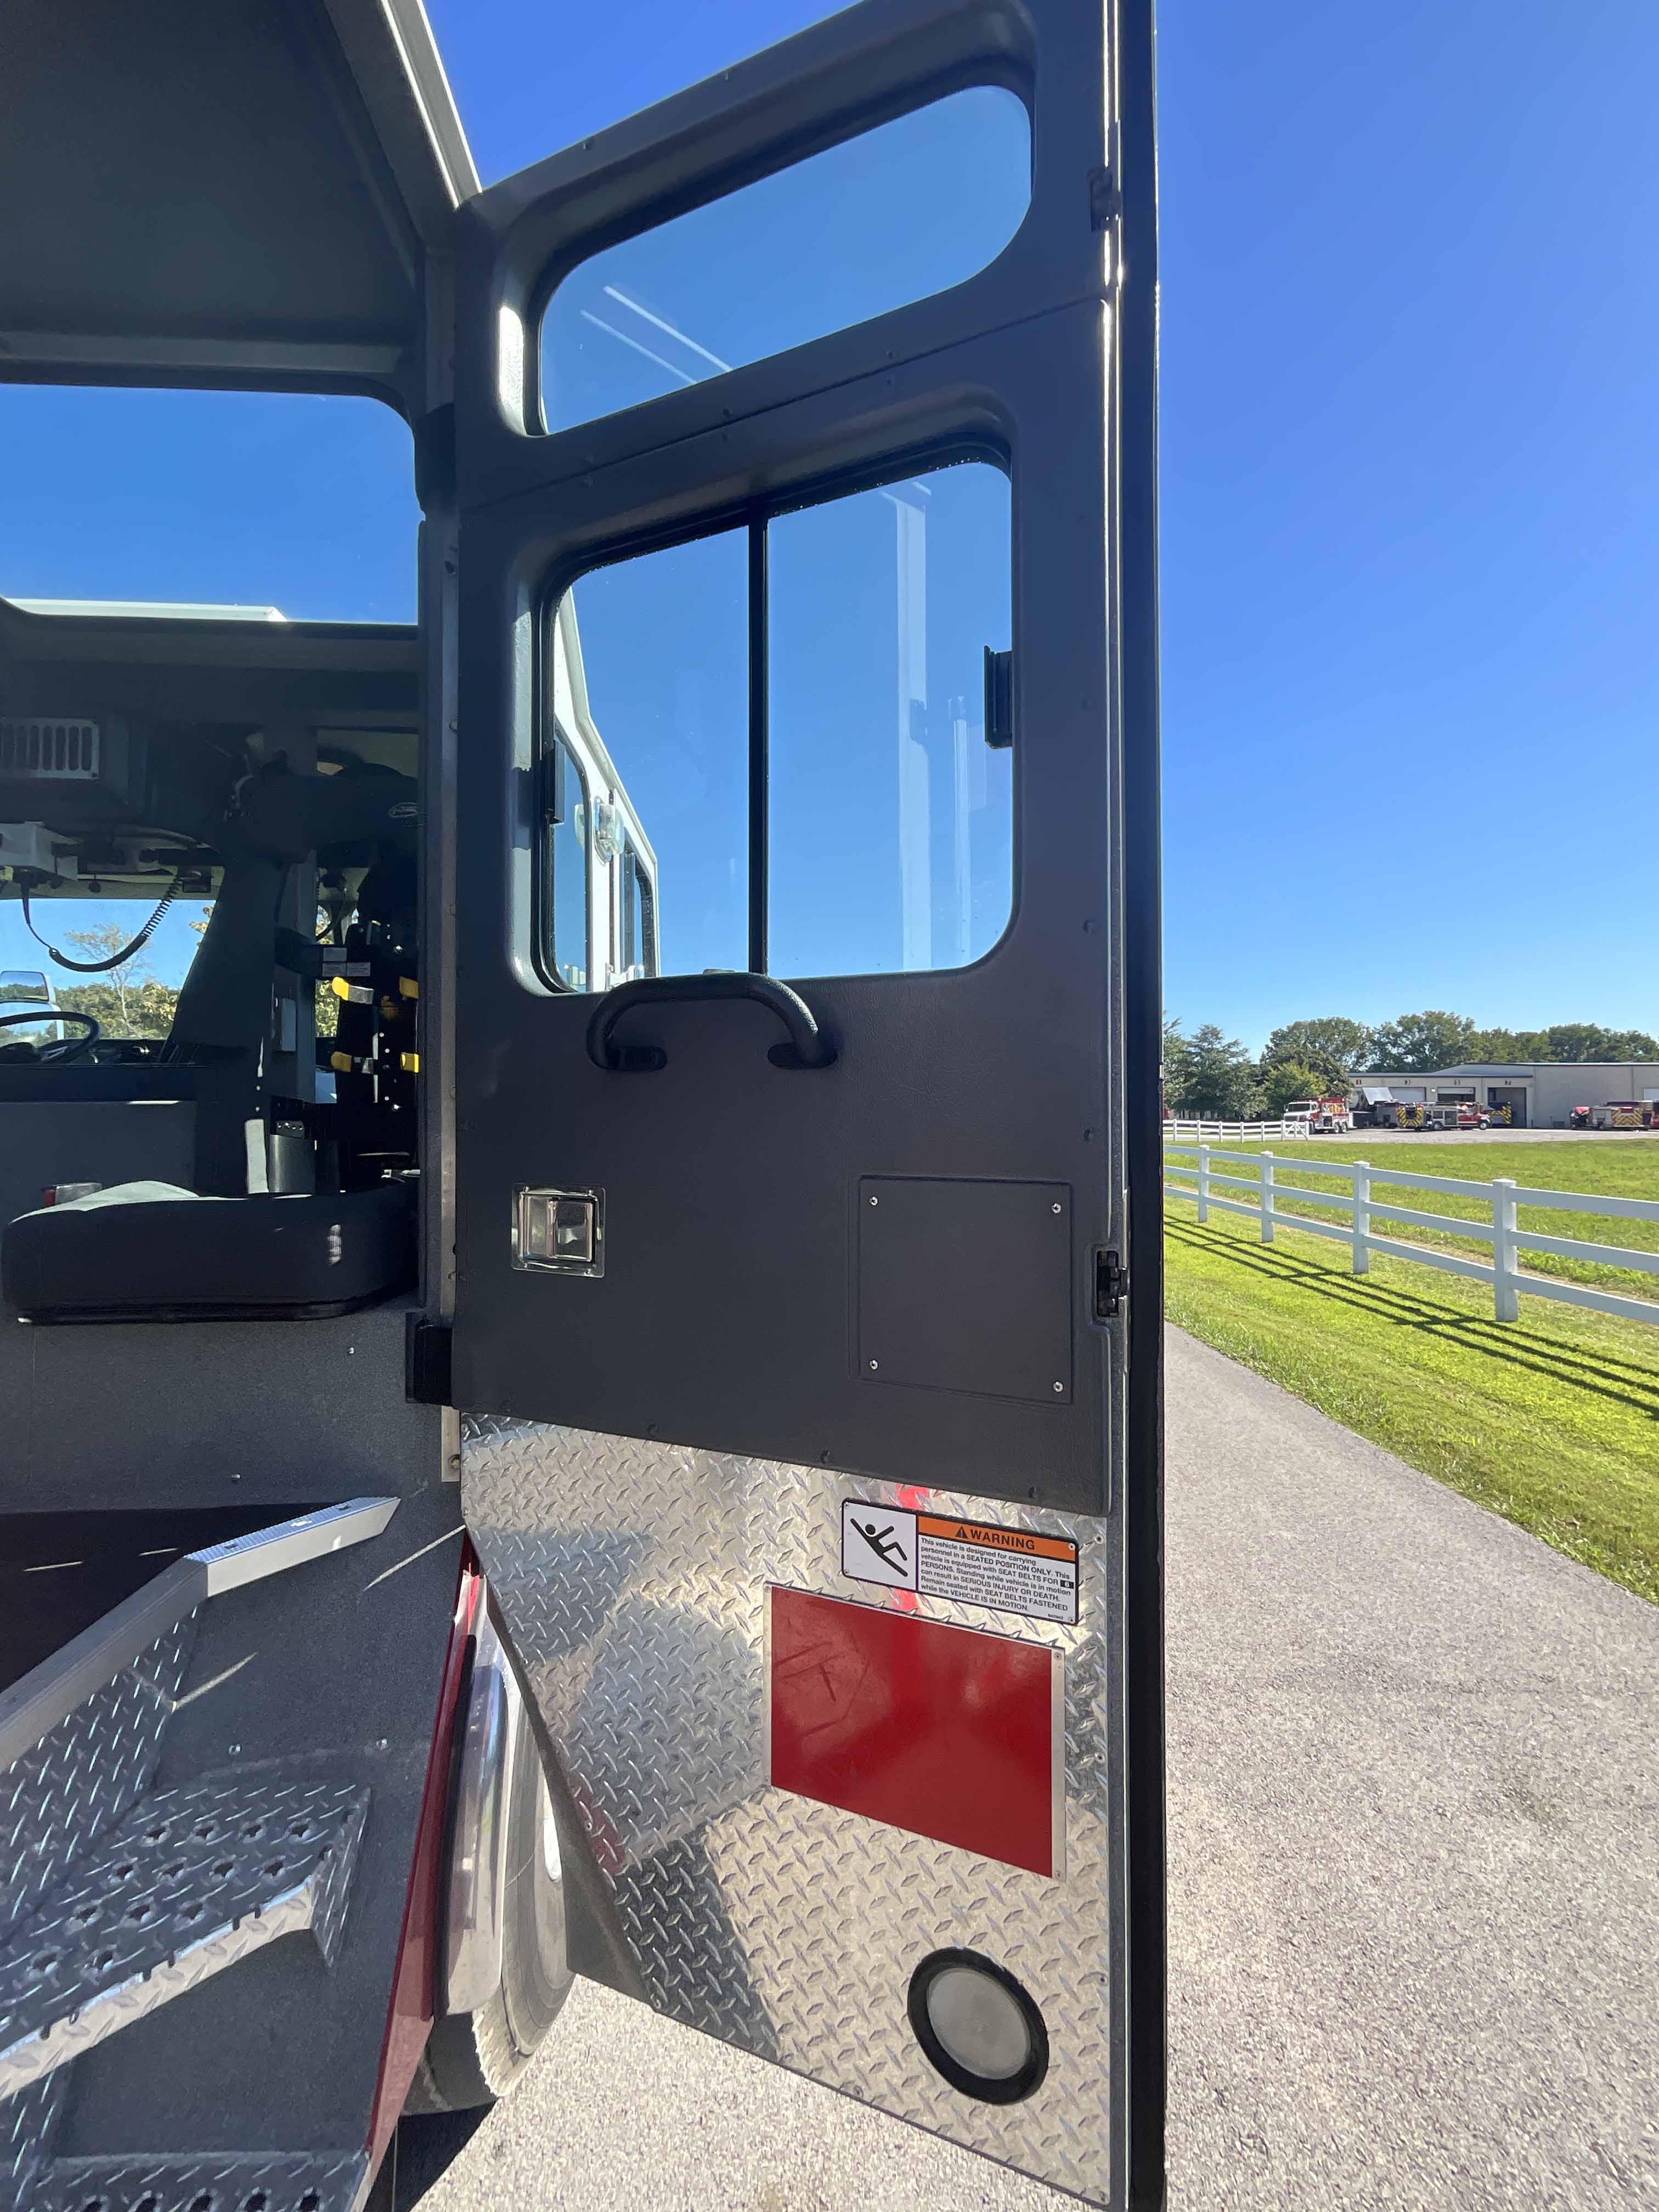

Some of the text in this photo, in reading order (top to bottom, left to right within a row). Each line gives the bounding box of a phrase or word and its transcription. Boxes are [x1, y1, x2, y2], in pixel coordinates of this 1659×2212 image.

[970, 1529, 1035, 1549] WARNING
[922, 1547, 952, 1557] personnel
[967, 1554, 994, 1565] SEATED
[996, 1560, 1029, 1571] POSITION
[1055, 1571, 1070, 1579] This
[935, 1541, 957, 1550] vehicle
[967, 1547, 996, 1557] designed
[1009, 1555, 1036, 1566] carrying
[922, 1554, 943, 1562] vehicle
[951, 1560, 981, 1570] equipped
[1019, 1572, 1041, 1582] BELTS
[922, 1560, 955, 1572] PERSONS.
[956, 1568, 985, 1579] Standing
[1006, 1578, 1029, 1587] vehicle
[1046, 1587, 1070, 1595] motion
[921, 1576, 945, 1585] Remain
[946, 1582, 968, 1590] seated
[985, 1589, 1003, 1598] SEAT
[1005, 1593, 1027, 1602] BELTS
[1029, 1598, 1068, 1611] FASTENED
[934, 1572, 952, 1580] result
[961, 1576, 991, 1588] SERIOUS
[993, 1583, 1019, 1593] INJURY
[1034, 1591, 1060, 1601] DEATH.
[951, 1590, 979, 1600] VEHICLE
[998, 1600, 1029, 1611] MOTION.
